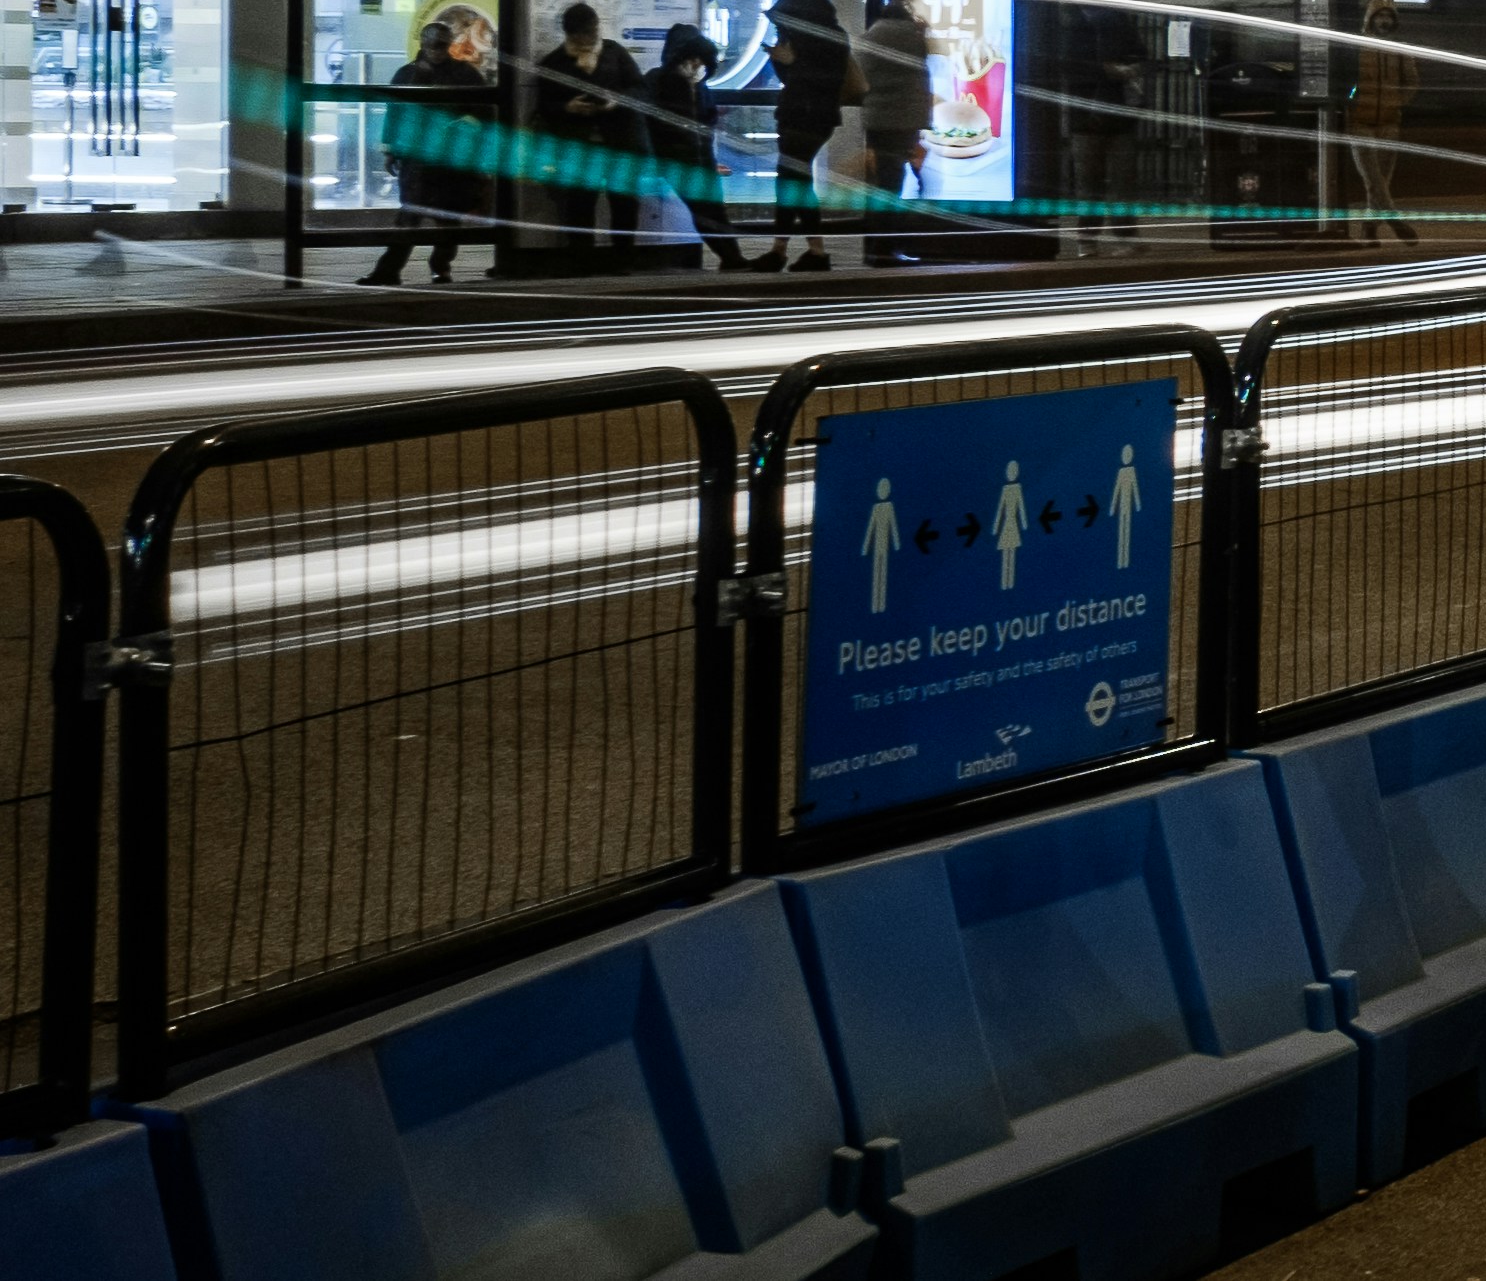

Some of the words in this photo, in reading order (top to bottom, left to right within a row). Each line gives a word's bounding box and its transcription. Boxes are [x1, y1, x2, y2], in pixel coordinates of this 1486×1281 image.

[838, 636, 922, 676] Please
[929, 623, 988, 657] keep
[994, 611, 1049, 651] your
[1055, 592, 1147, 632] distance
[852, 691, 880, 711] This
[884, 690, 895, 706] is
[898, 684, 918, 702] for
[920, 679, 951, 701] your
[953, 669, 994, 693] safety
[996, 662, 1021, 683] and
[1023, 657, 1044, 675] the
[1045, 650, 1084, 673] safety
[1085, 645, 1100, 663] of
[1101, 640, 1137, 660] others
[809, 758, 848, 780] MAYOR
[851, 752, 867, 770] OF
[869, 743, 918, 768] LONDON
[956, 748, 1018, 780] Lambeth
